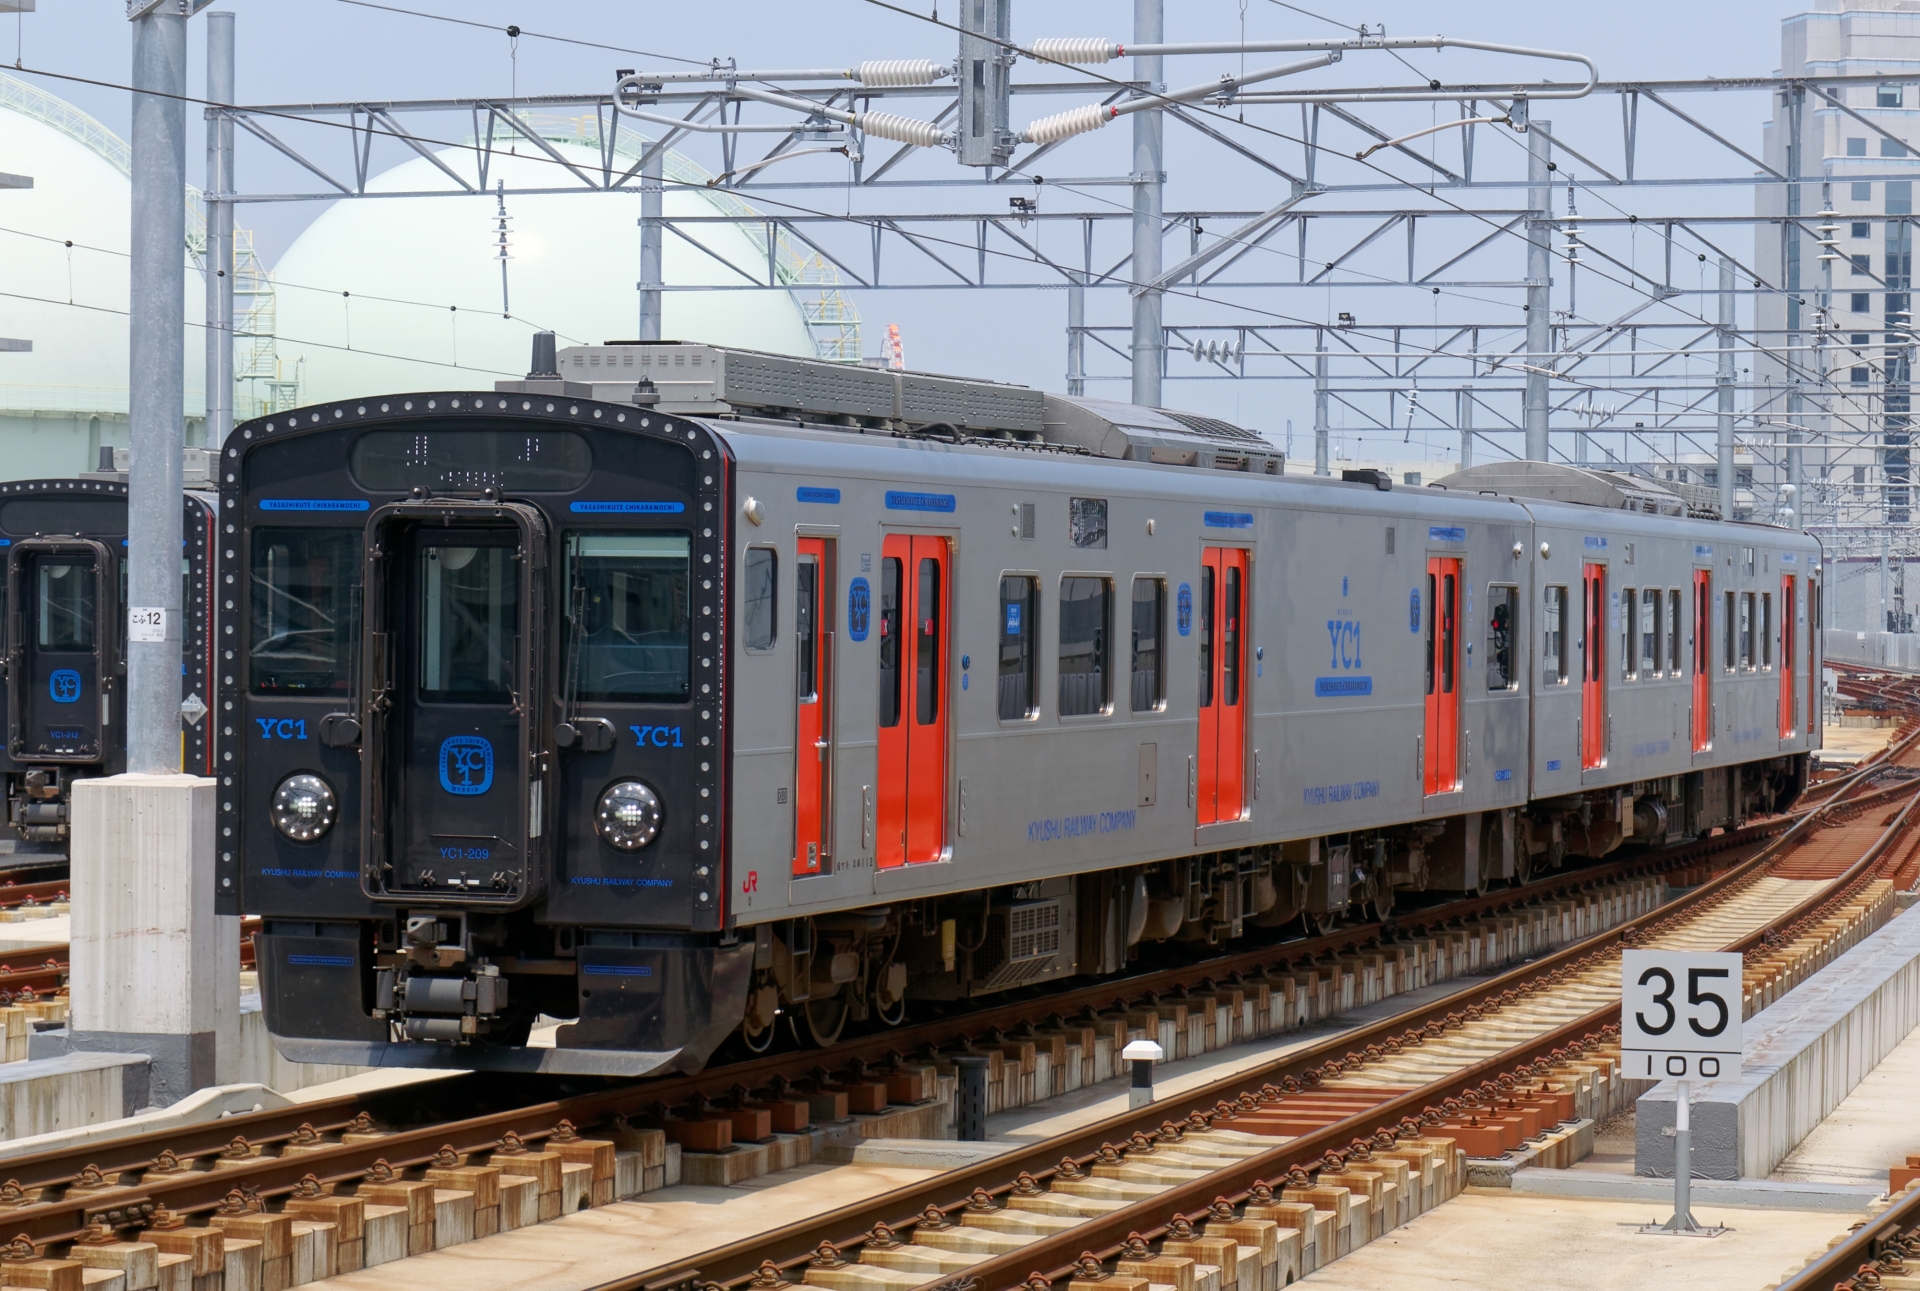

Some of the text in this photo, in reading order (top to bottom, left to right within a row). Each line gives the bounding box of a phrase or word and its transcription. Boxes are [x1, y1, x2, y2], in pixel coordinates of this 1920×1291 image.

[1327, 620, 1362, 669] YC1
[255, 718, 308, 740] YC1
[629, 725, 684, 747] YC1
[1028, 809, 1136, 842] KYUSHU RAILWAY COMPANY
[440, 847, 489, 859] YC1-209
[261, 868, 360, 878] KYUSHU RAILWAY COMPANY
[571, 877, 673, 887] KYUSHU RAILWAY COMPANY
[743, 870, 757, 893] JR
[1635, 967, 1729, 1037] 35
[1647, 1054, 1720, 1077] 100
